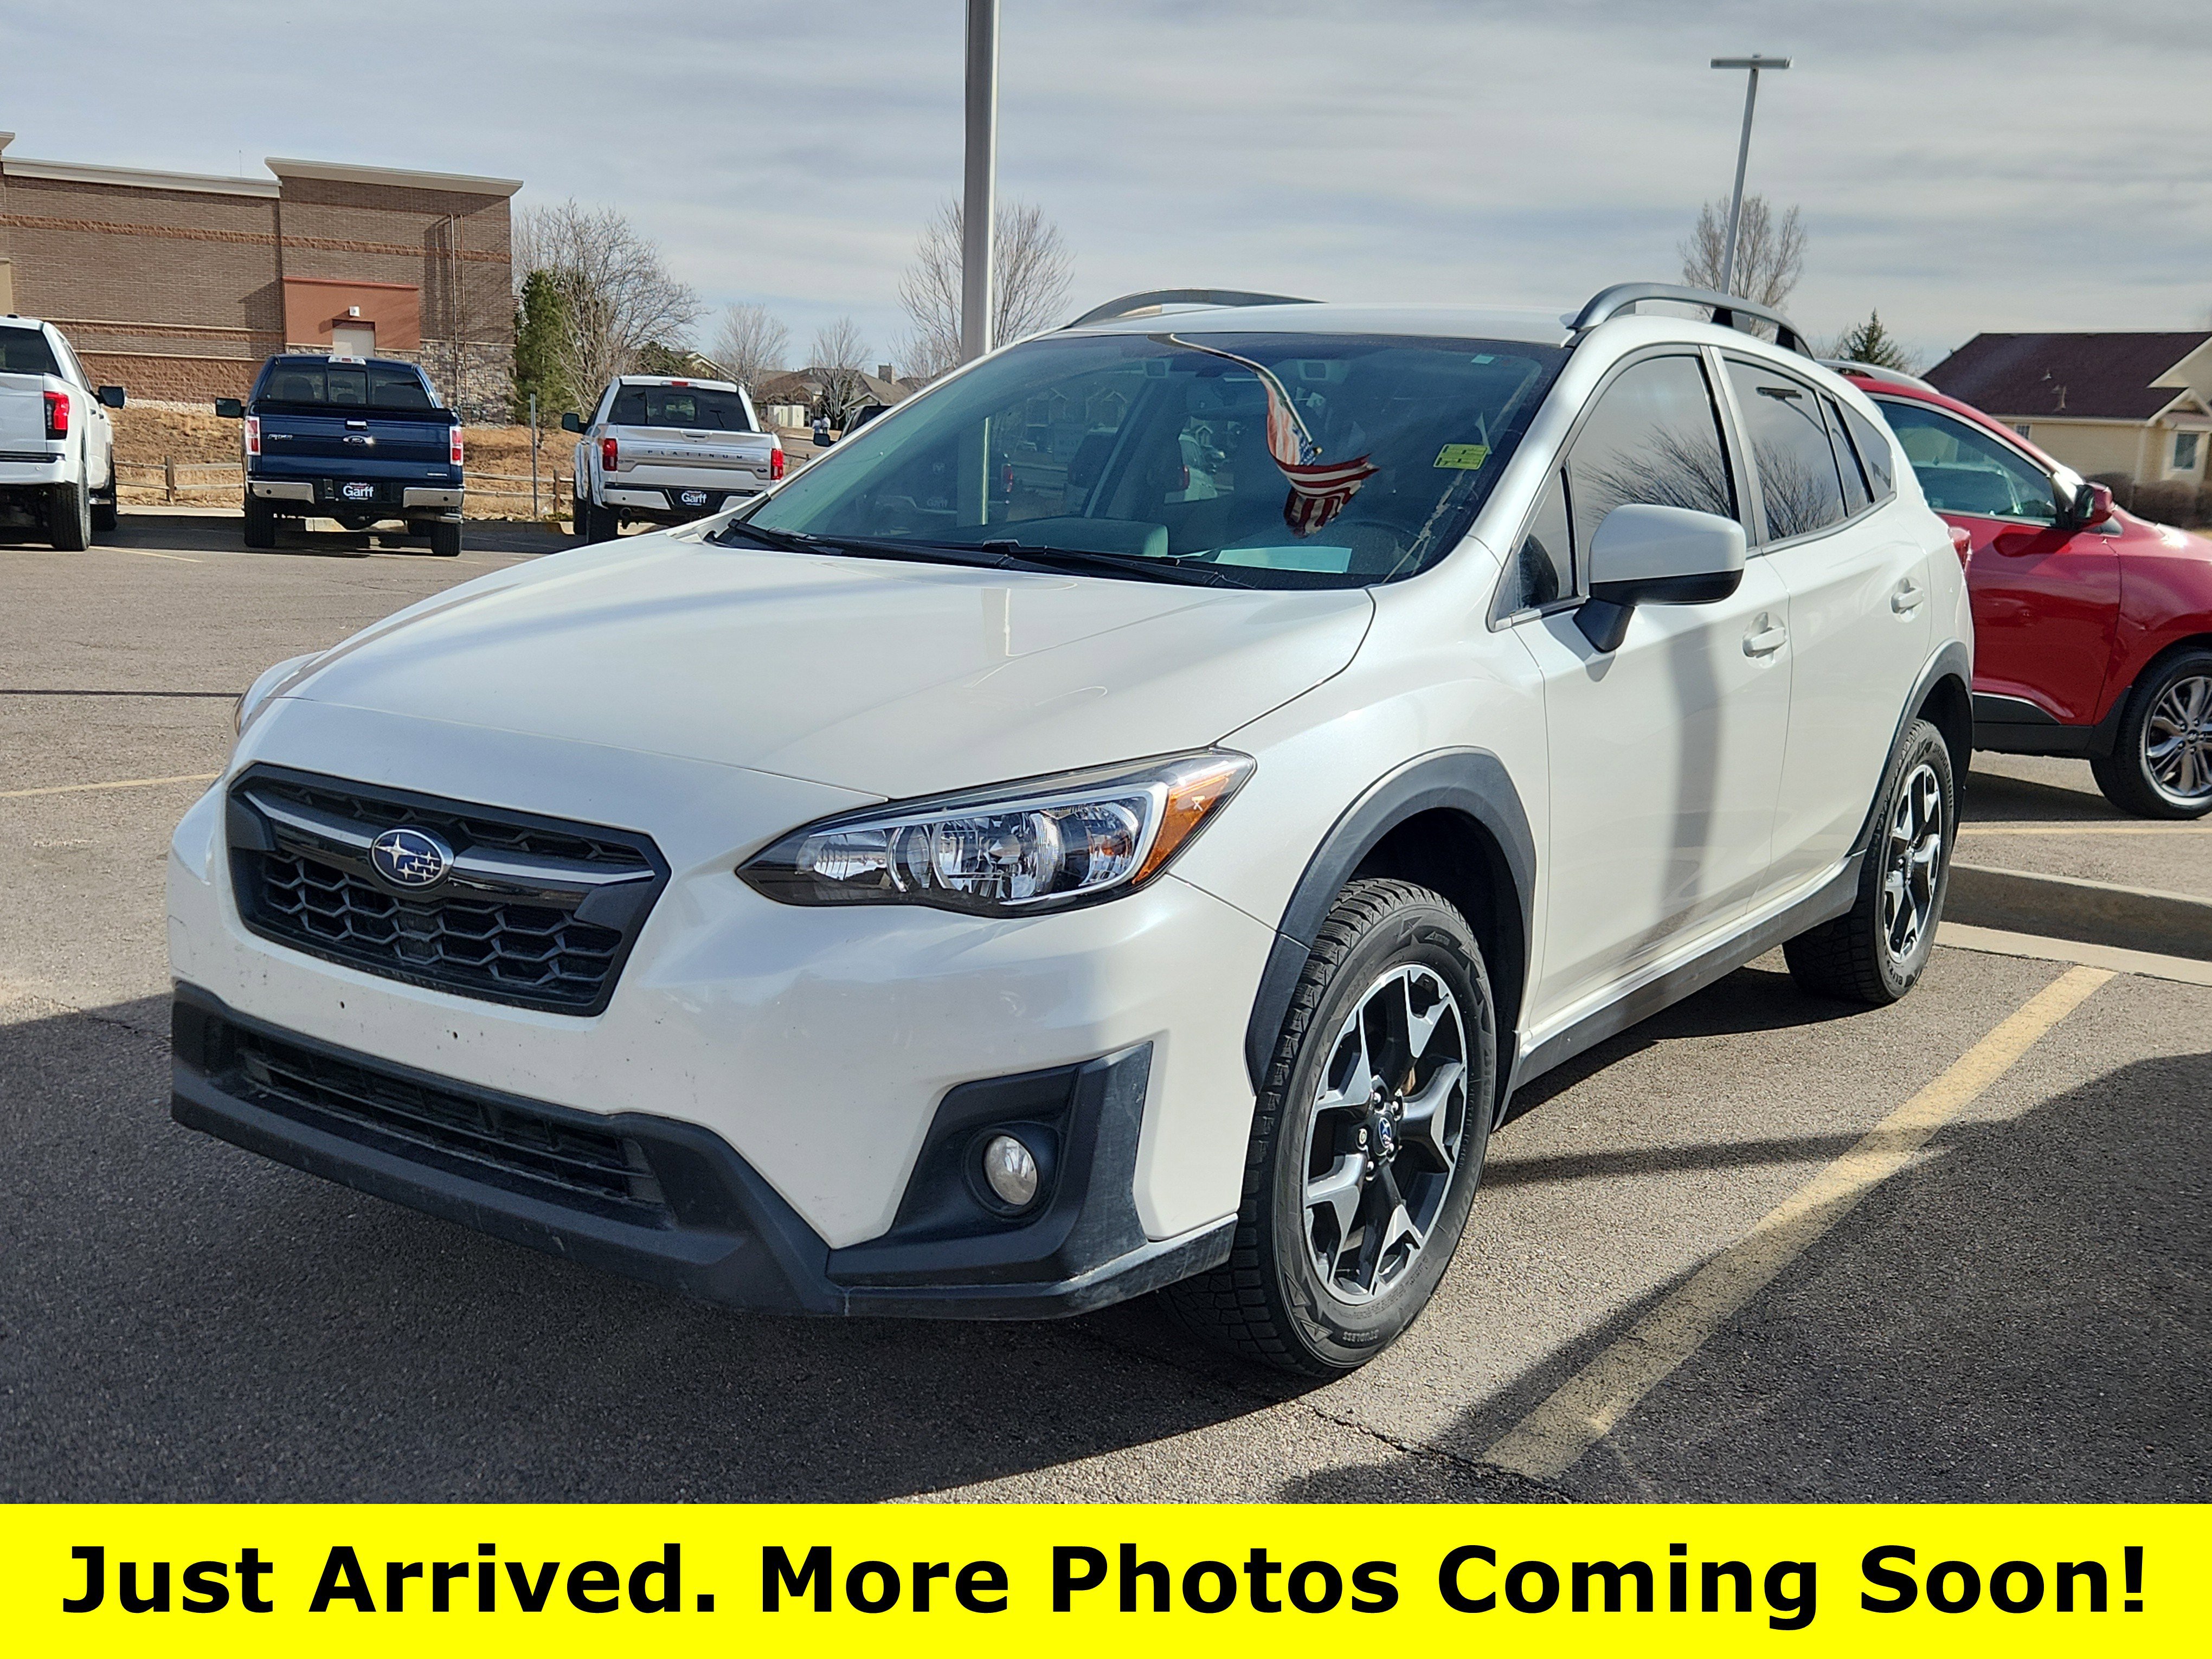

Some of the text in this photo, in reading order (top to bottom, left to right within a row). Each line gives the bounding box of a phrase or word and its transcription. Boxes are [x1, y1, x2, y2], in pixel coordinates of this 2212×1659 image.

[647, 450, 743, 459] PLATINUM
[343, 485, 374, 497] Garff
[681, 492, 707, 504] Garff
[1342, 1329, 1379, 1342] STUDLESS
